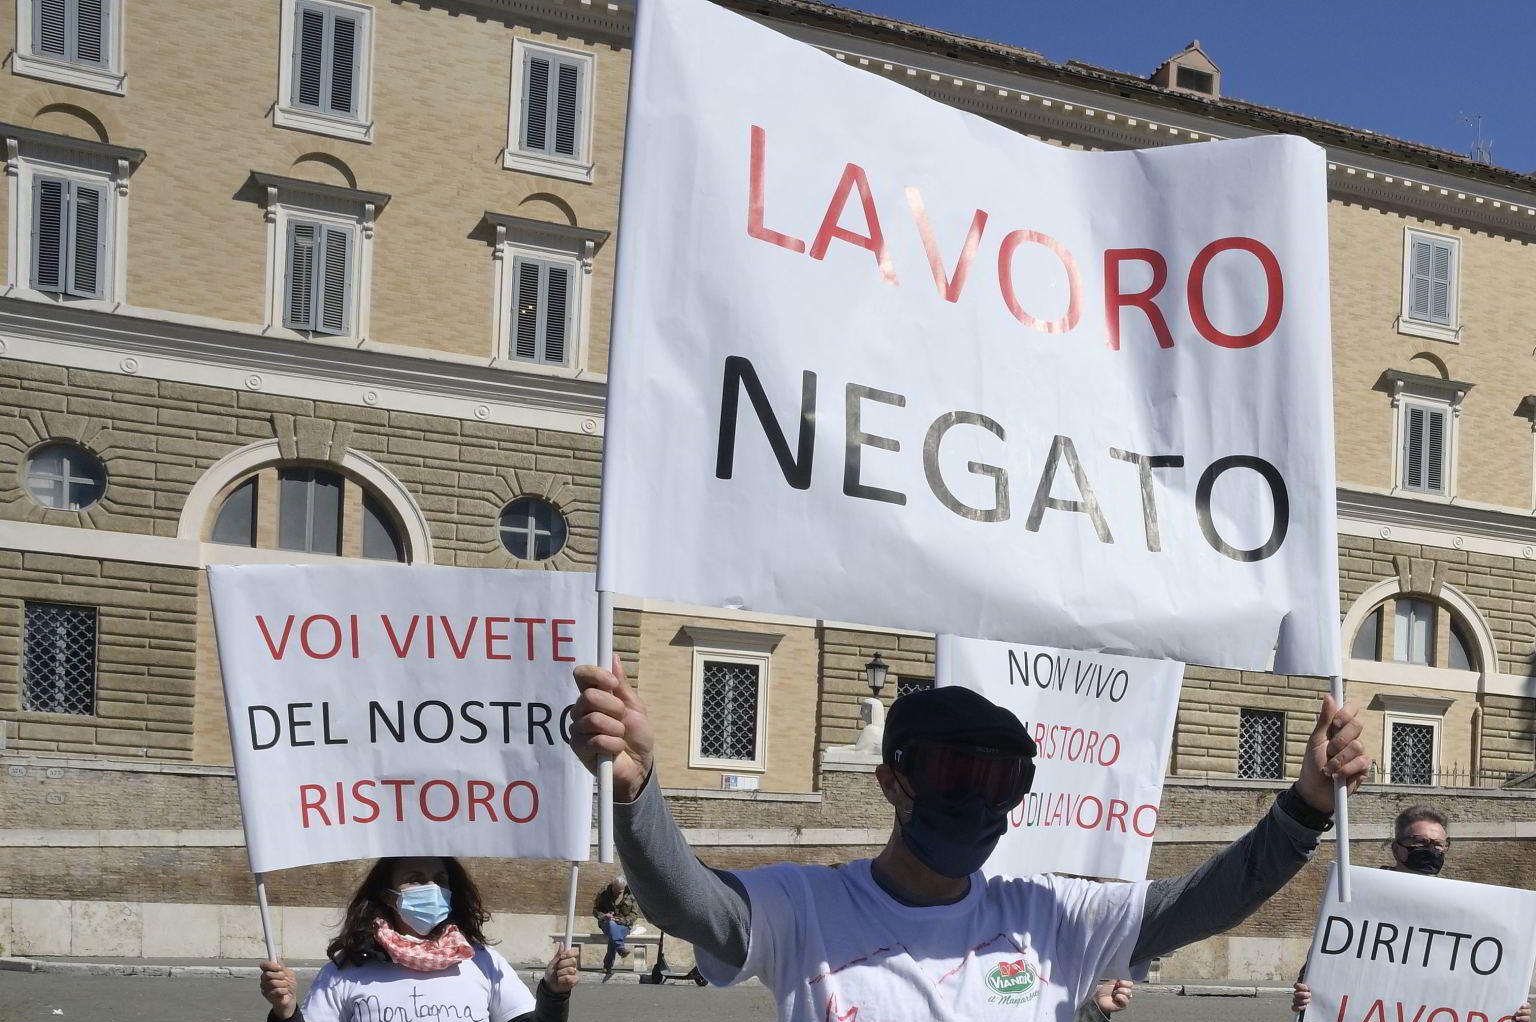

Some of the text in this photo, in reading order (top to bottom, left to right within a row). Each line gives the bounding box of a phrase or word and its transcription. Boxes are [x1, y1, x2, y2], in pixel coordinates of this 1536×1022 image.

[747, 125, 1284, 350] LAVORO
[715, 356, 1289, 562] NEGATO
[256, 614, 576, 662] VOI VIVETE
[1008, 649, 1129, 702] NON VIVO
[248, 702, 348, 750] DEL
[1034, 722, 1120, 766] RISTORO
[299, 780, 539, 829] RISTORO
[1320, 915, 1504, 976] DIRITTO
